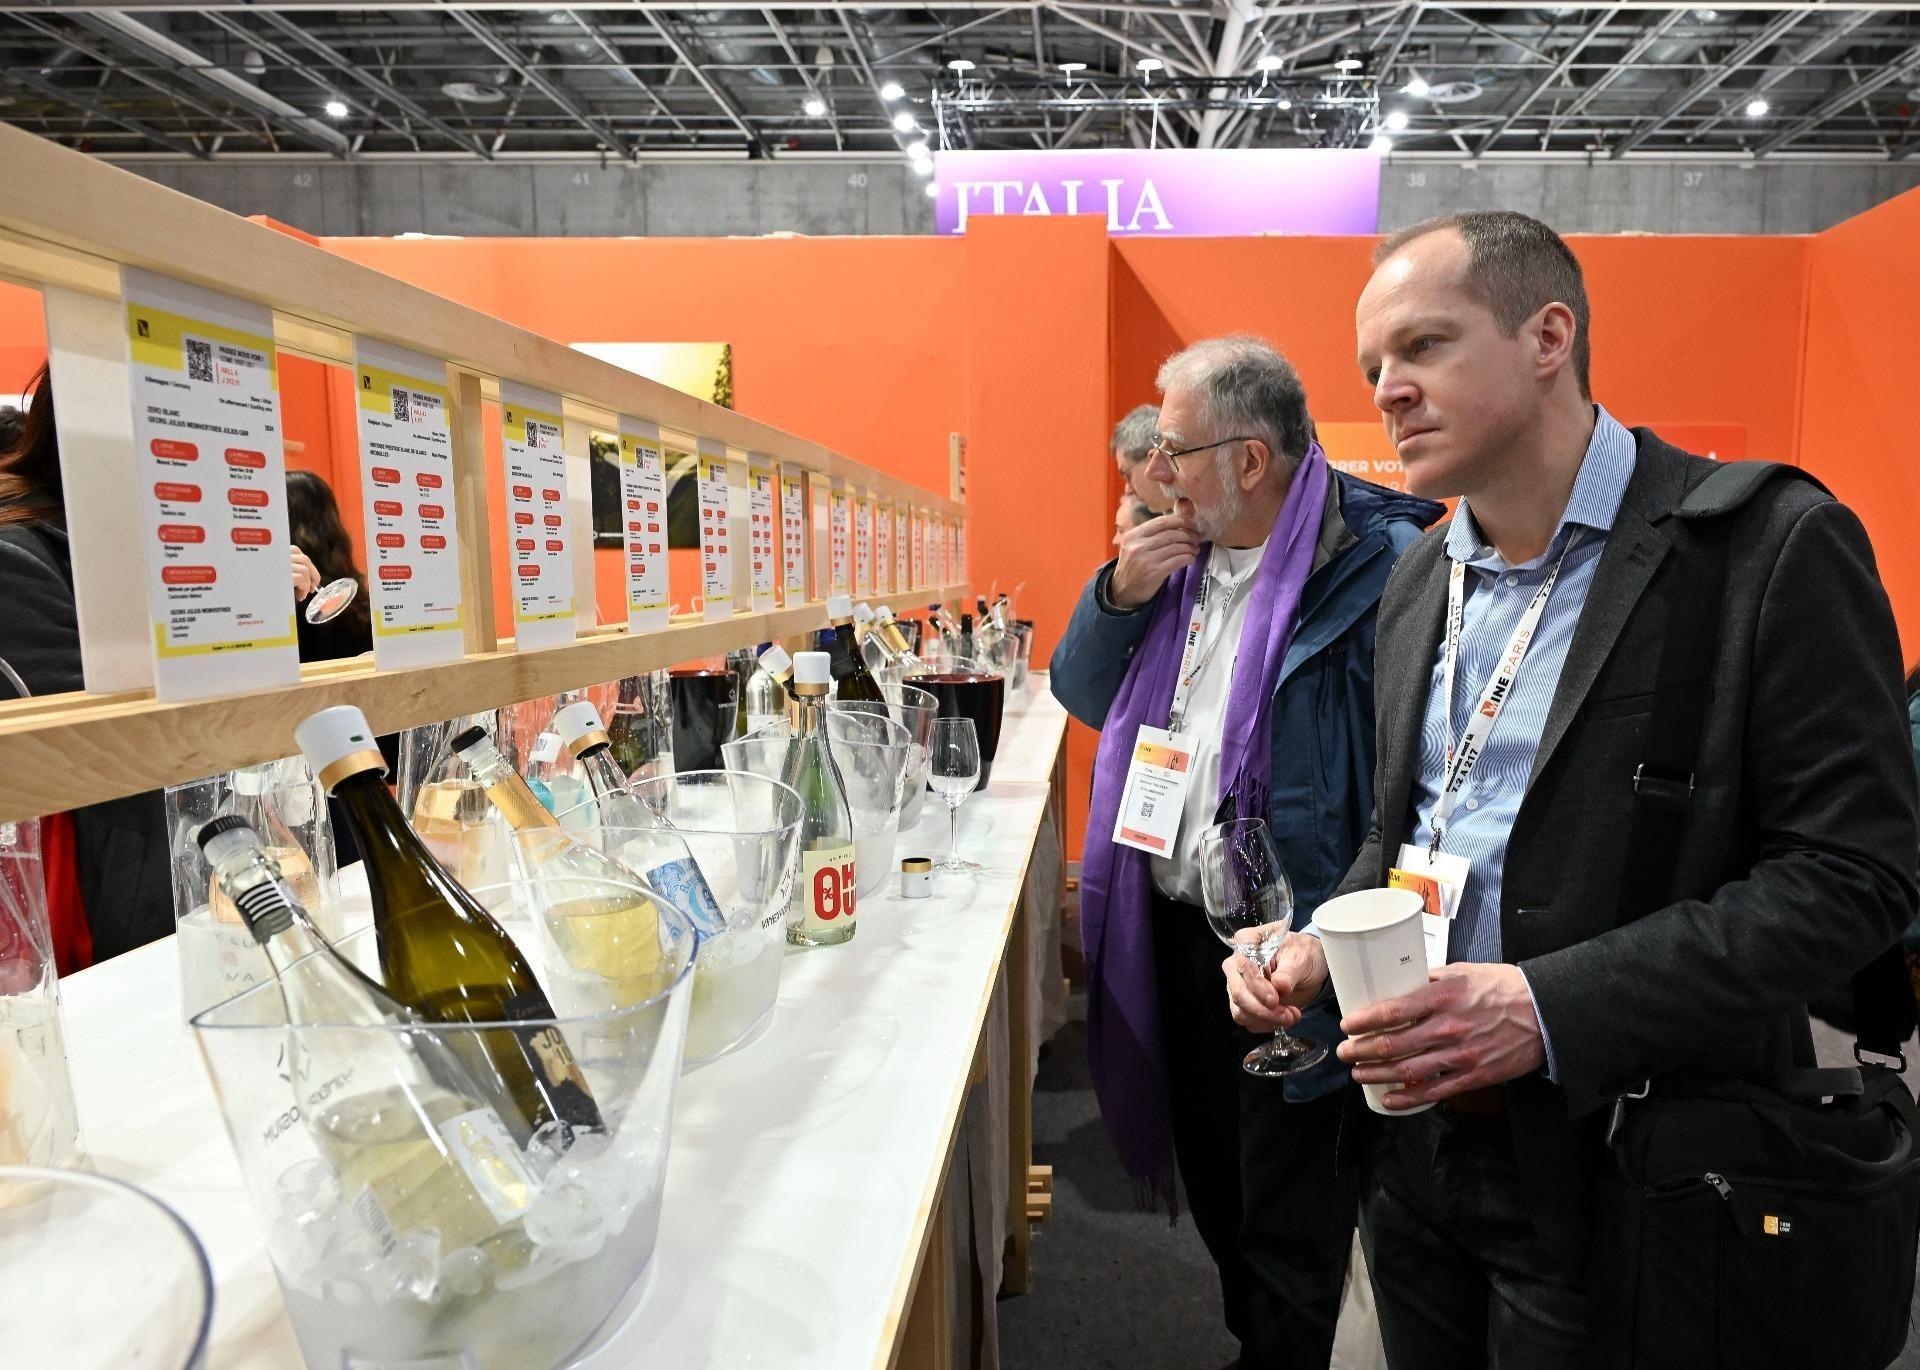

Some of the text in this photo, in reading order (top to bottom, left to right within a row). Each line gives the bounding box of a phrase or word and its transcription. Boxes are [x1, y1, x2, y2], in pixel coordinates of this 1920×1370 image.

[293, 173, 312, 187] 42
[571, 173, 590, 187] 41
[848, 172, 869, 187] 40
[1406, 171, 1426, 187] 38
[1684, 171, 1703, 187] 37
[952, 178, 1174, 234] ITALIA
[1503, 629, 1531, 676] PARIS
[1468, 748, 1479, 769] 217
